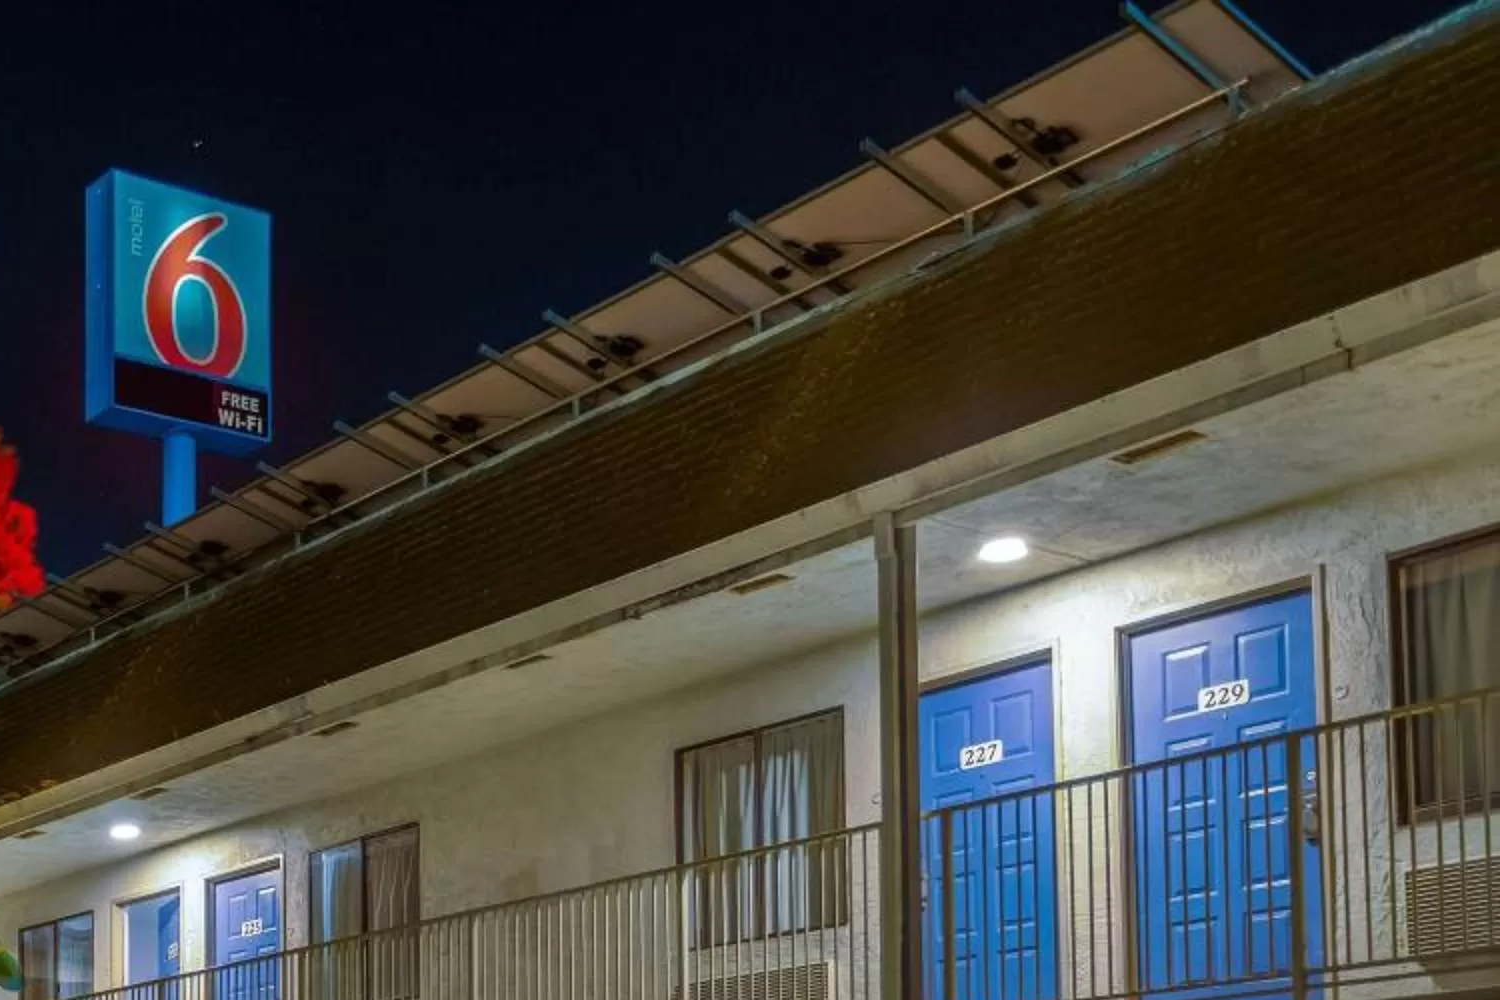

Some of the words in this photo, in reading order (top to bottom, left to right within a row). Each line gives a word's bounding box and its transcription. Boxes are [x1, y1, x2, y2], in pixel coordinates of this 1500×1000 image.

[128, 198, 146, 256] motel
[143, 212, 247, 378] 6
[221, 390, 260, 412] FREE
[218, 407, 263, 433] Wi-Fi
[1203, 683, 1245, 709] 229
[964, 743, 998, 767] 227
